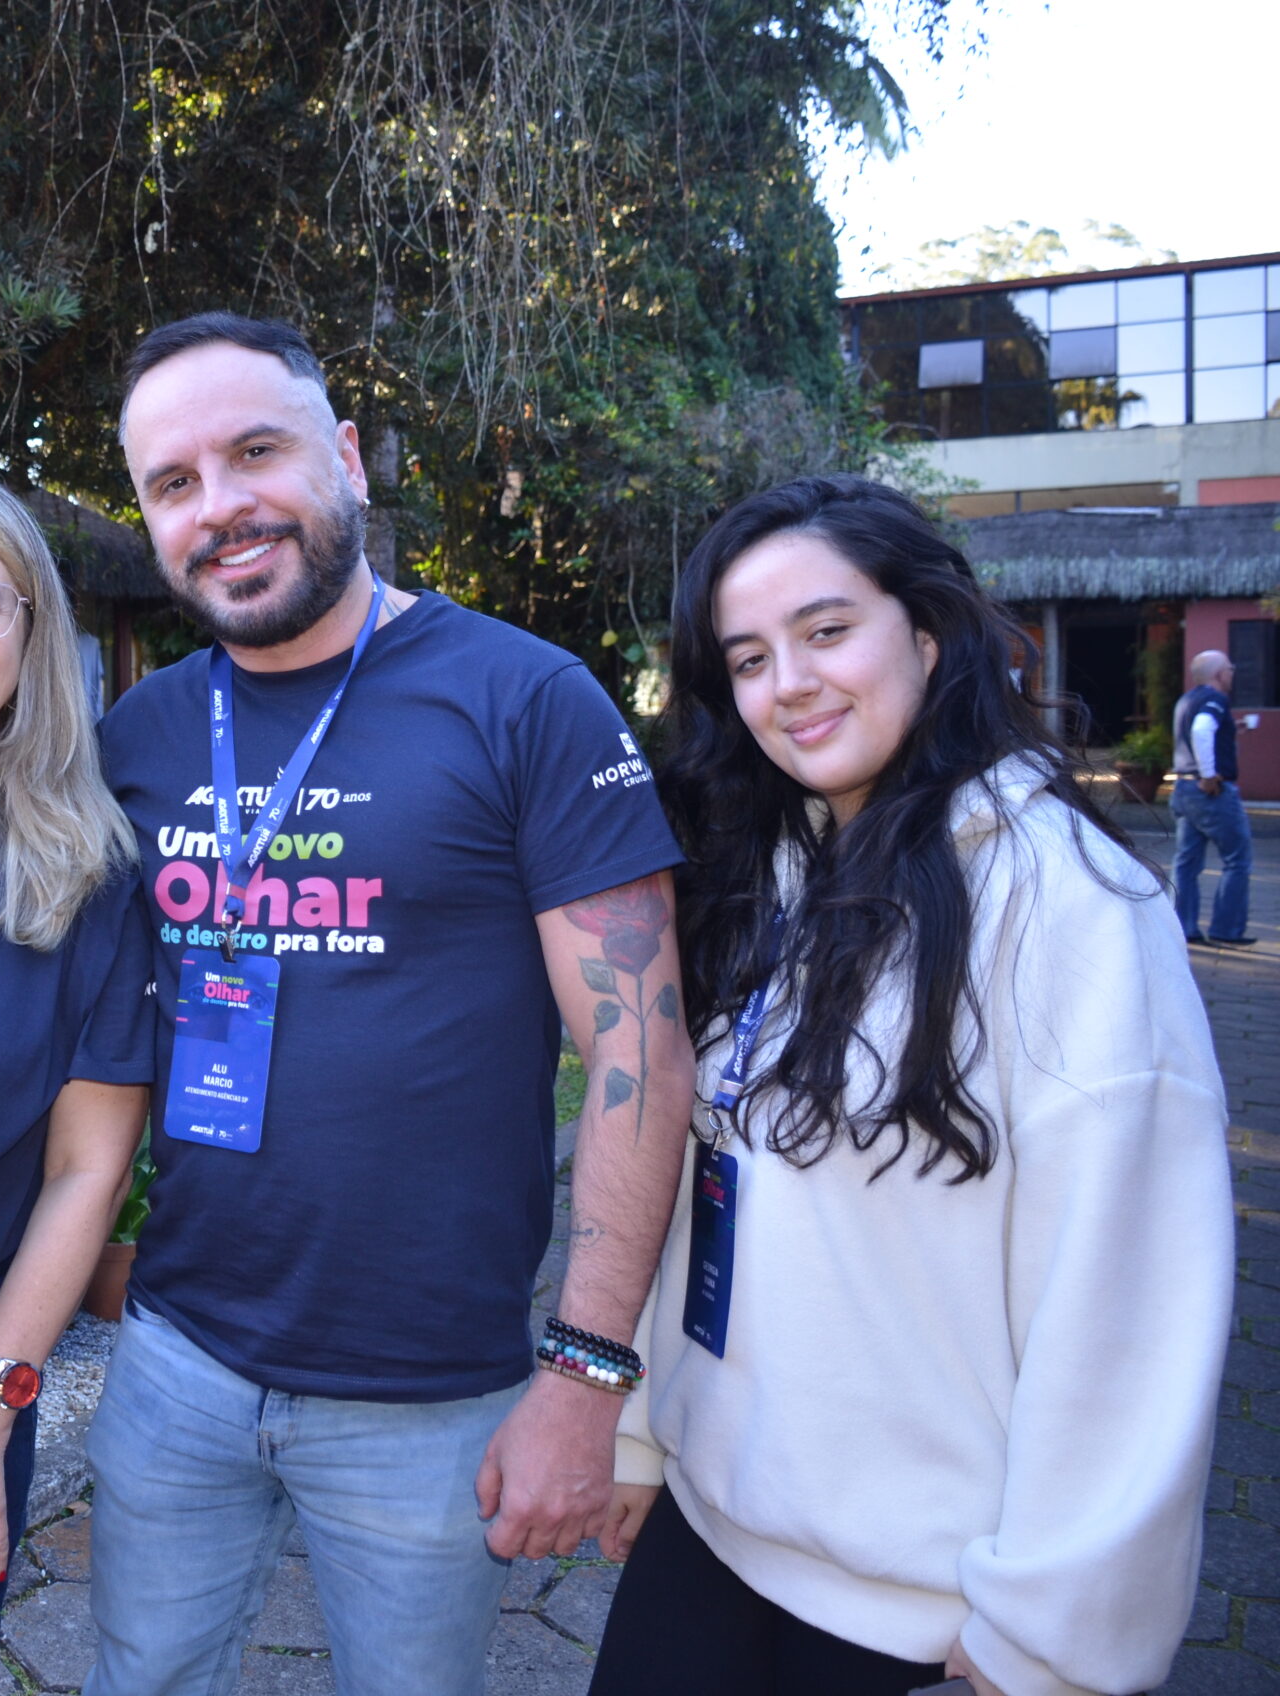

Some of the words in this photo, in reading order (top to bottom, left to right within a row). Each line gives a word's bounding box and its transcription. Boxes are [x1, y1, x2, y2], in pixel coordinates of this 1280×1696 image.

[214, 689, 222, 721] AGAXTUR
[215, 727, 223, 739] 70
[311, 708, 332, 745] AGAXTUR
[304, 788, 340, 811] 70
[342, 791, 372, 804] anos
[218, 797, 229, 834] AGAXTUR
[157, 826, 220, 857] Um
[247, 827, 270, 868] AGAXTUR
[269, 807, 281, 821] 70
[221, 843, 231, 856] 70
[154, 860, 383, 928] Olhar
[160, 924, 181, 943] de
[273, 931, 319, 955] pra
[326, 930, 385, 954] fora
[205, 972, 220, 982] Um
[222, 976, 244, 985] novo
[204, 982, 250, 1002] Olhar
[212, 1063, 228, 1074] ALU
[184, 1086, 218, 1099] ATENDIMENTO
[203, 1075, 233, 1089] MARCIO
